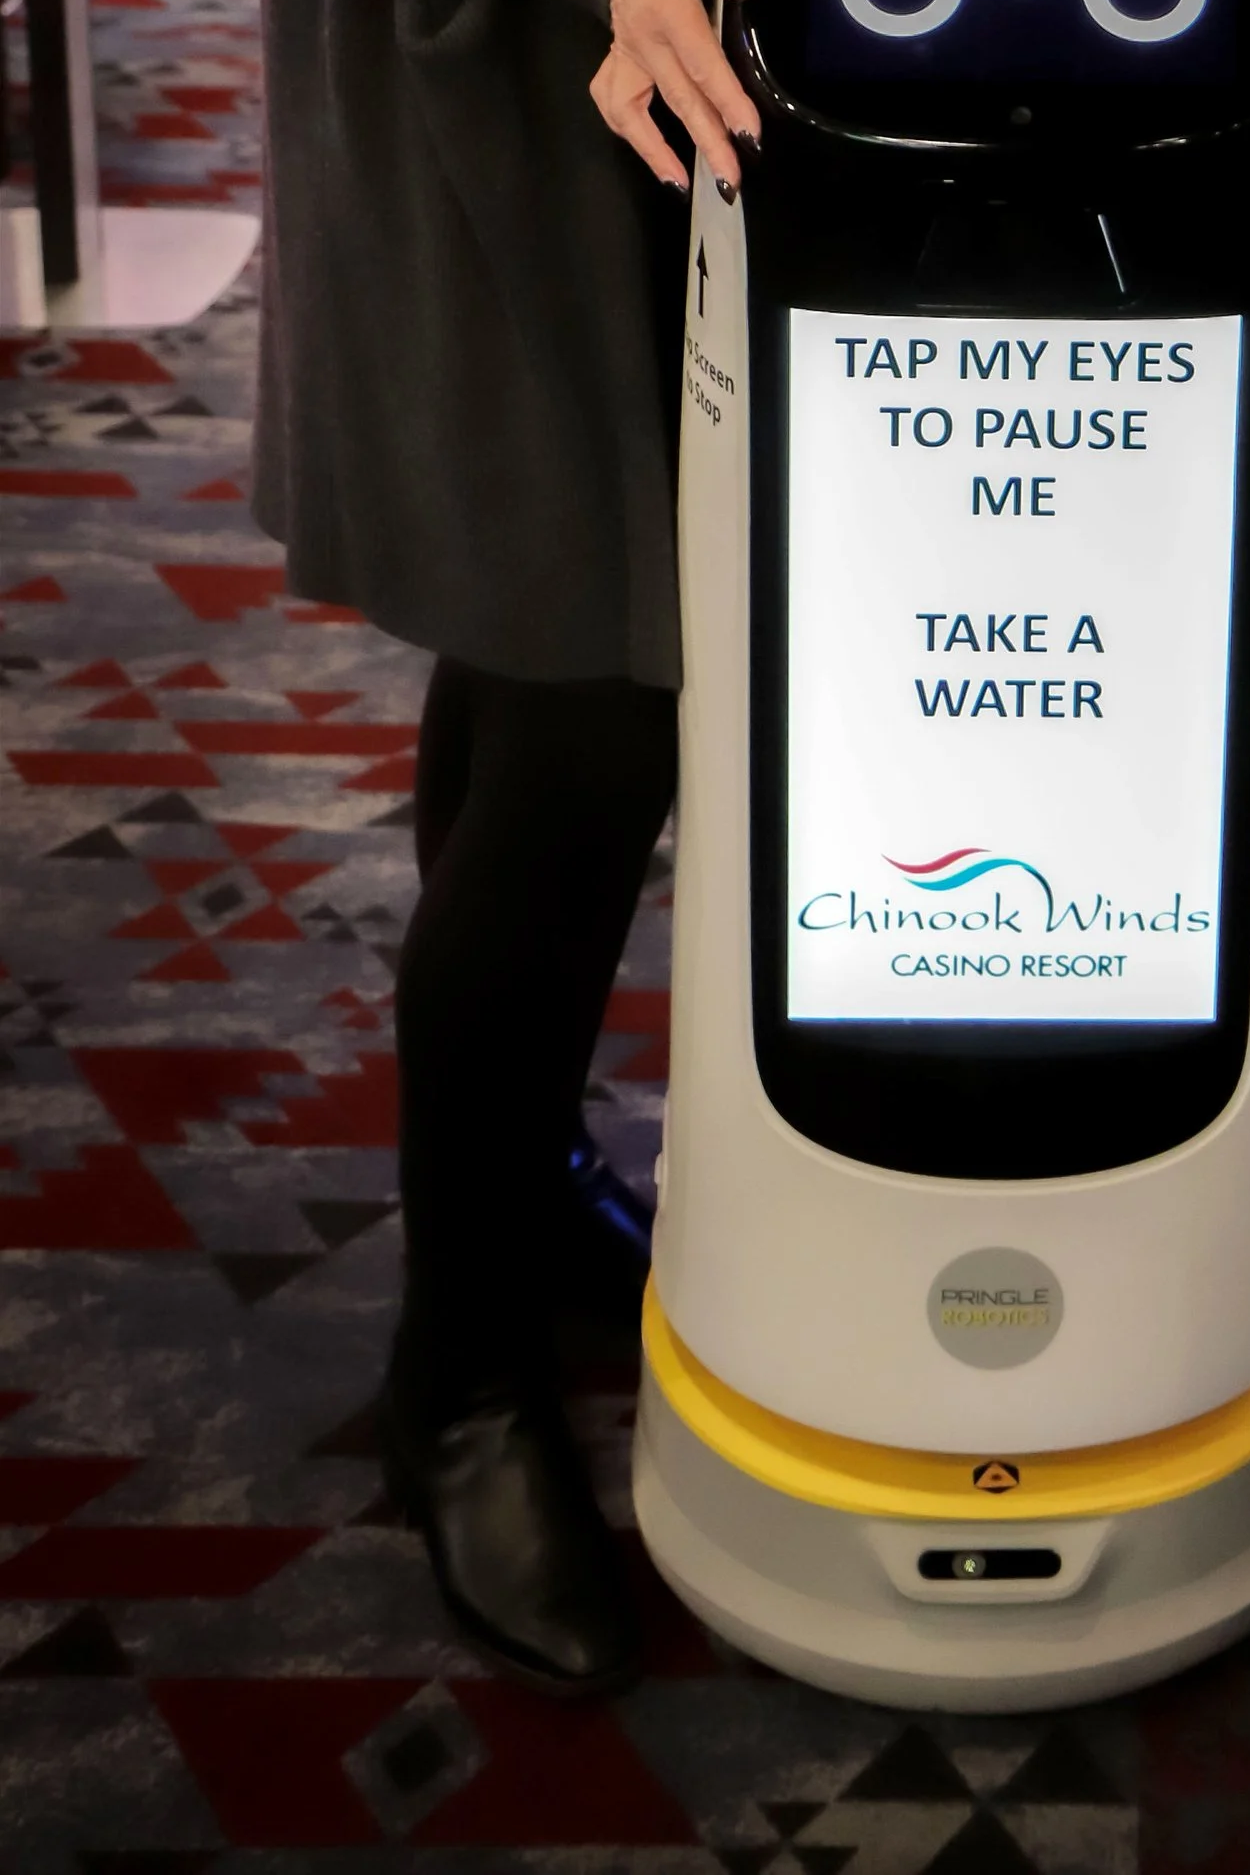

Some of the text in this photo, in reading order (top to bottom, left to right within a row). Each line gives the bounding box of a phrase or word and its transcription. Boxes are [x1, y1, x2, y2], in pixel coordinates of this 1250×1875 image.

[694, 341, 735, 395] Screen
[834, 337, 1195, 383] TAP MY EYES
[695, 382, 721, 426] Stop
[879, 407, 1148, 450] TO PAUSE
[972, 476, 1056, 517] ME
[915, 613, 1105, 654] TAKE A
[914, 679, 1103, 719] WATER
[797, 870, 1211, 933] Chinook Winds
[891, 954, 1127, 978] CASINO RESORT
[940, 1288, 1050, 1306] PRINGLE
